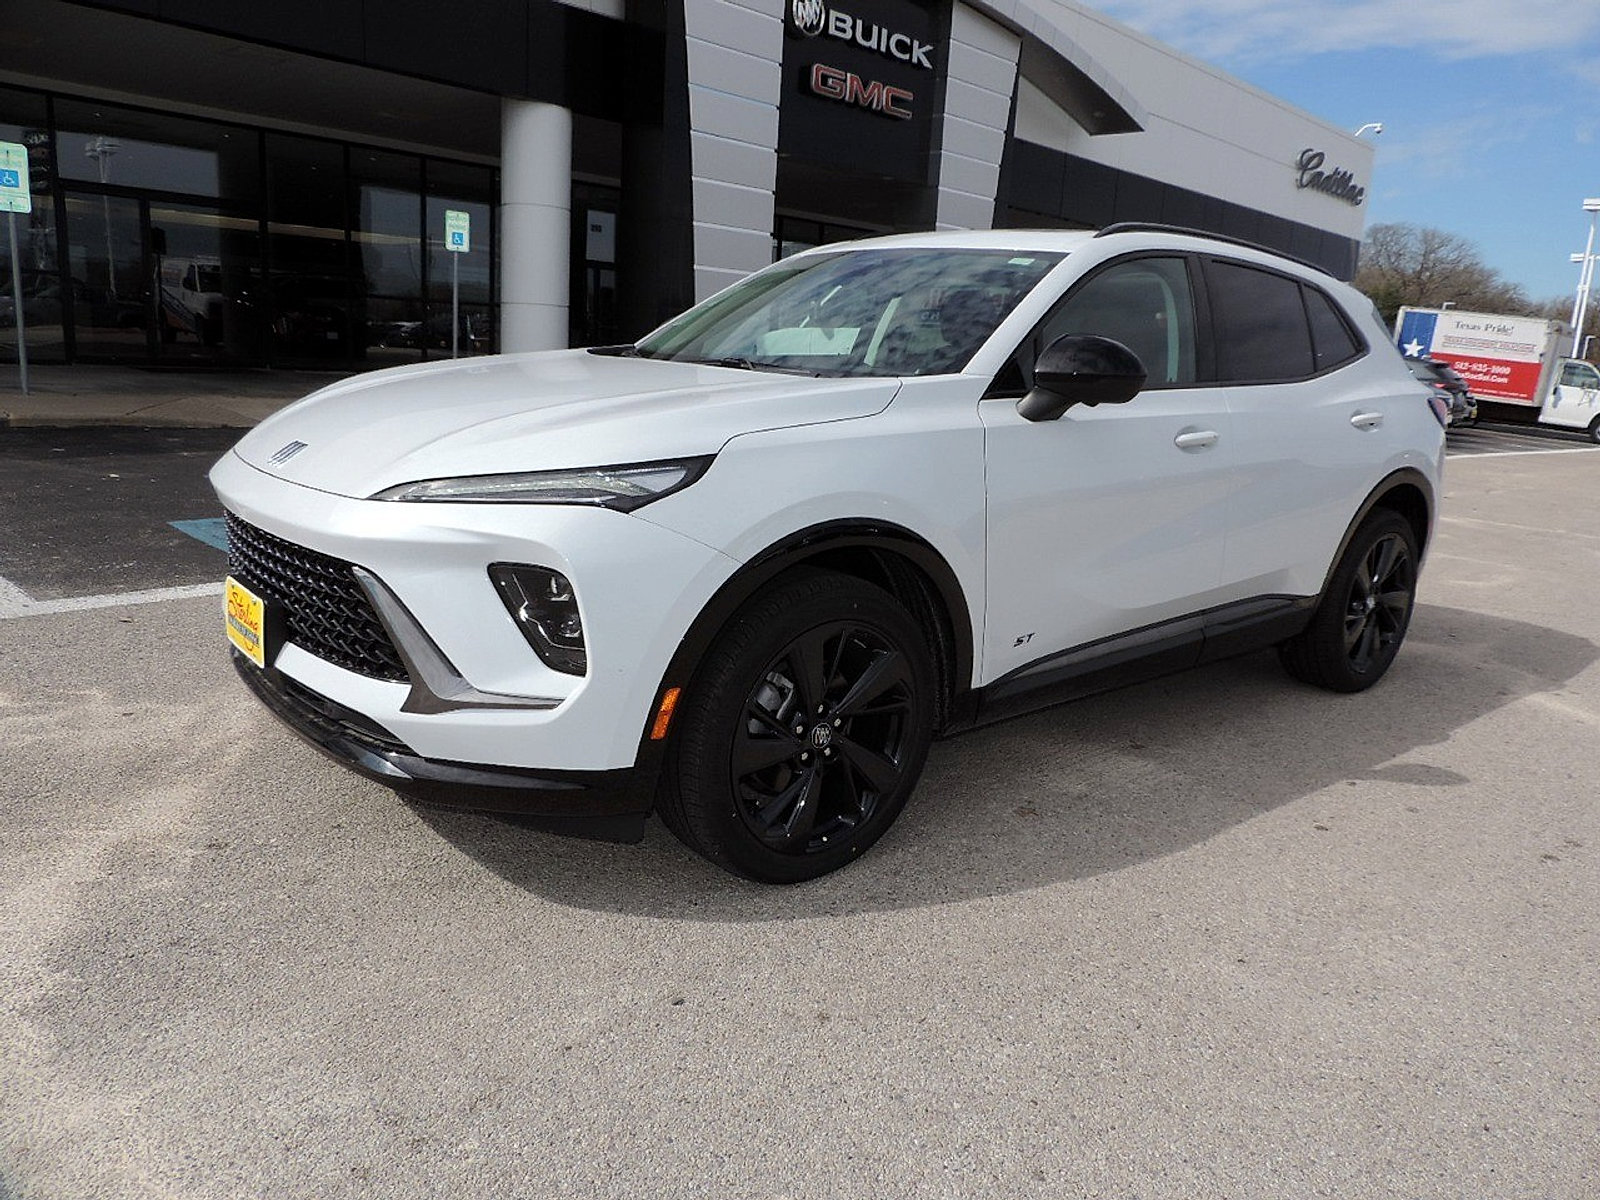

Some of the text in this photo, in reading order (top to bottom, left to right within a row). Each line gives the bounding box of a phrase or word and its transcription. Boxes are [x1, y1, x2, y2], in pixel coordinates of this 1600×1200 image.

[828, 9, 934, 69] BUICK
[811, 63, 914, 120] GMC
[1296, 148, 1364, 206] Cadillac
[1454, 321, 1481, 331] Texas
[1013, 632, 1035, 648] ST
